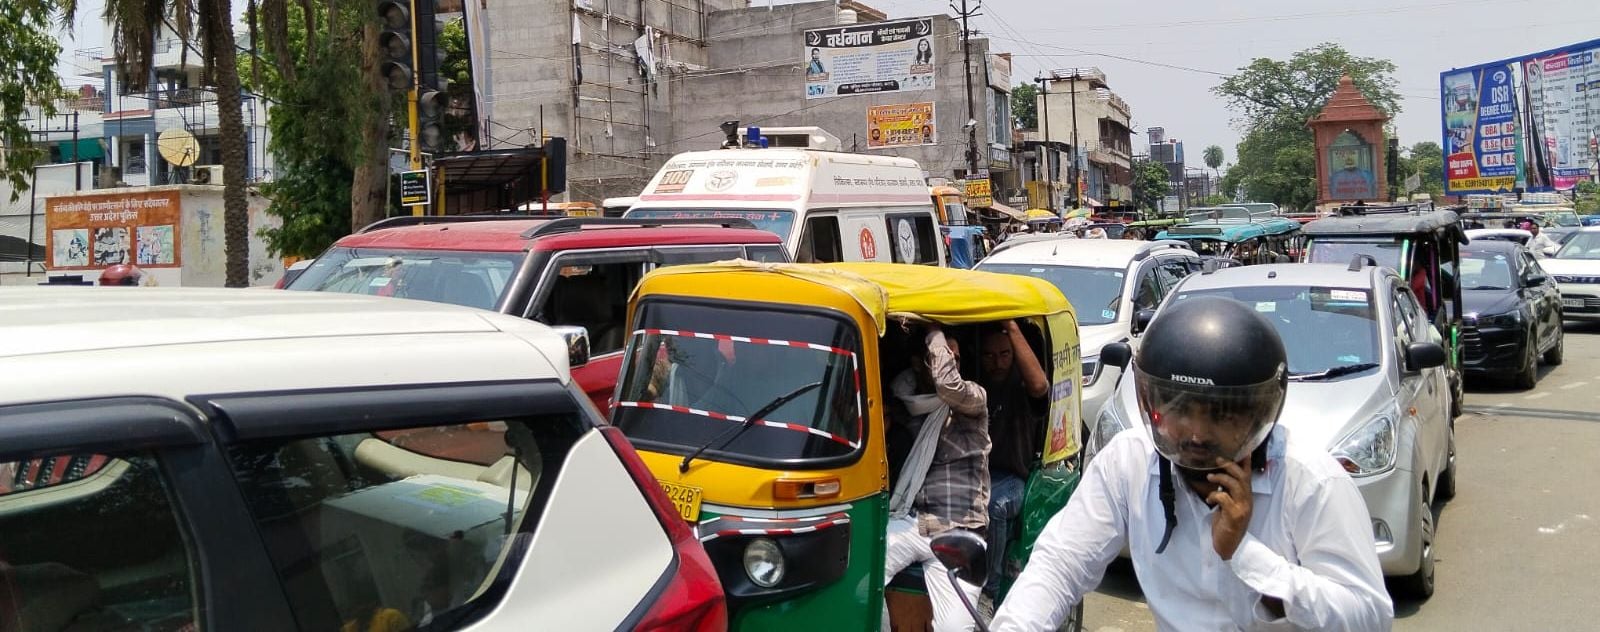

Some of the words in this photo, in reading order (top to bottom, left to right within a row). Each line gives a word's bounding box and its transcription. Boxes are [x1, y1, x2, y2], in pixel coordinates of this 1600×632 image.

[826, 29, 873, 47] वर्धमान
[1491, 85, 1509, 104] DSR
[1480, 104, 1500, 117] DEGREE
[1485, 125, 1498, 136] BBA
[661, 171, 692, 184] 108
[1171, 374, 1215, 386] HONDA
[662, 484, 700, 503] P24BT
